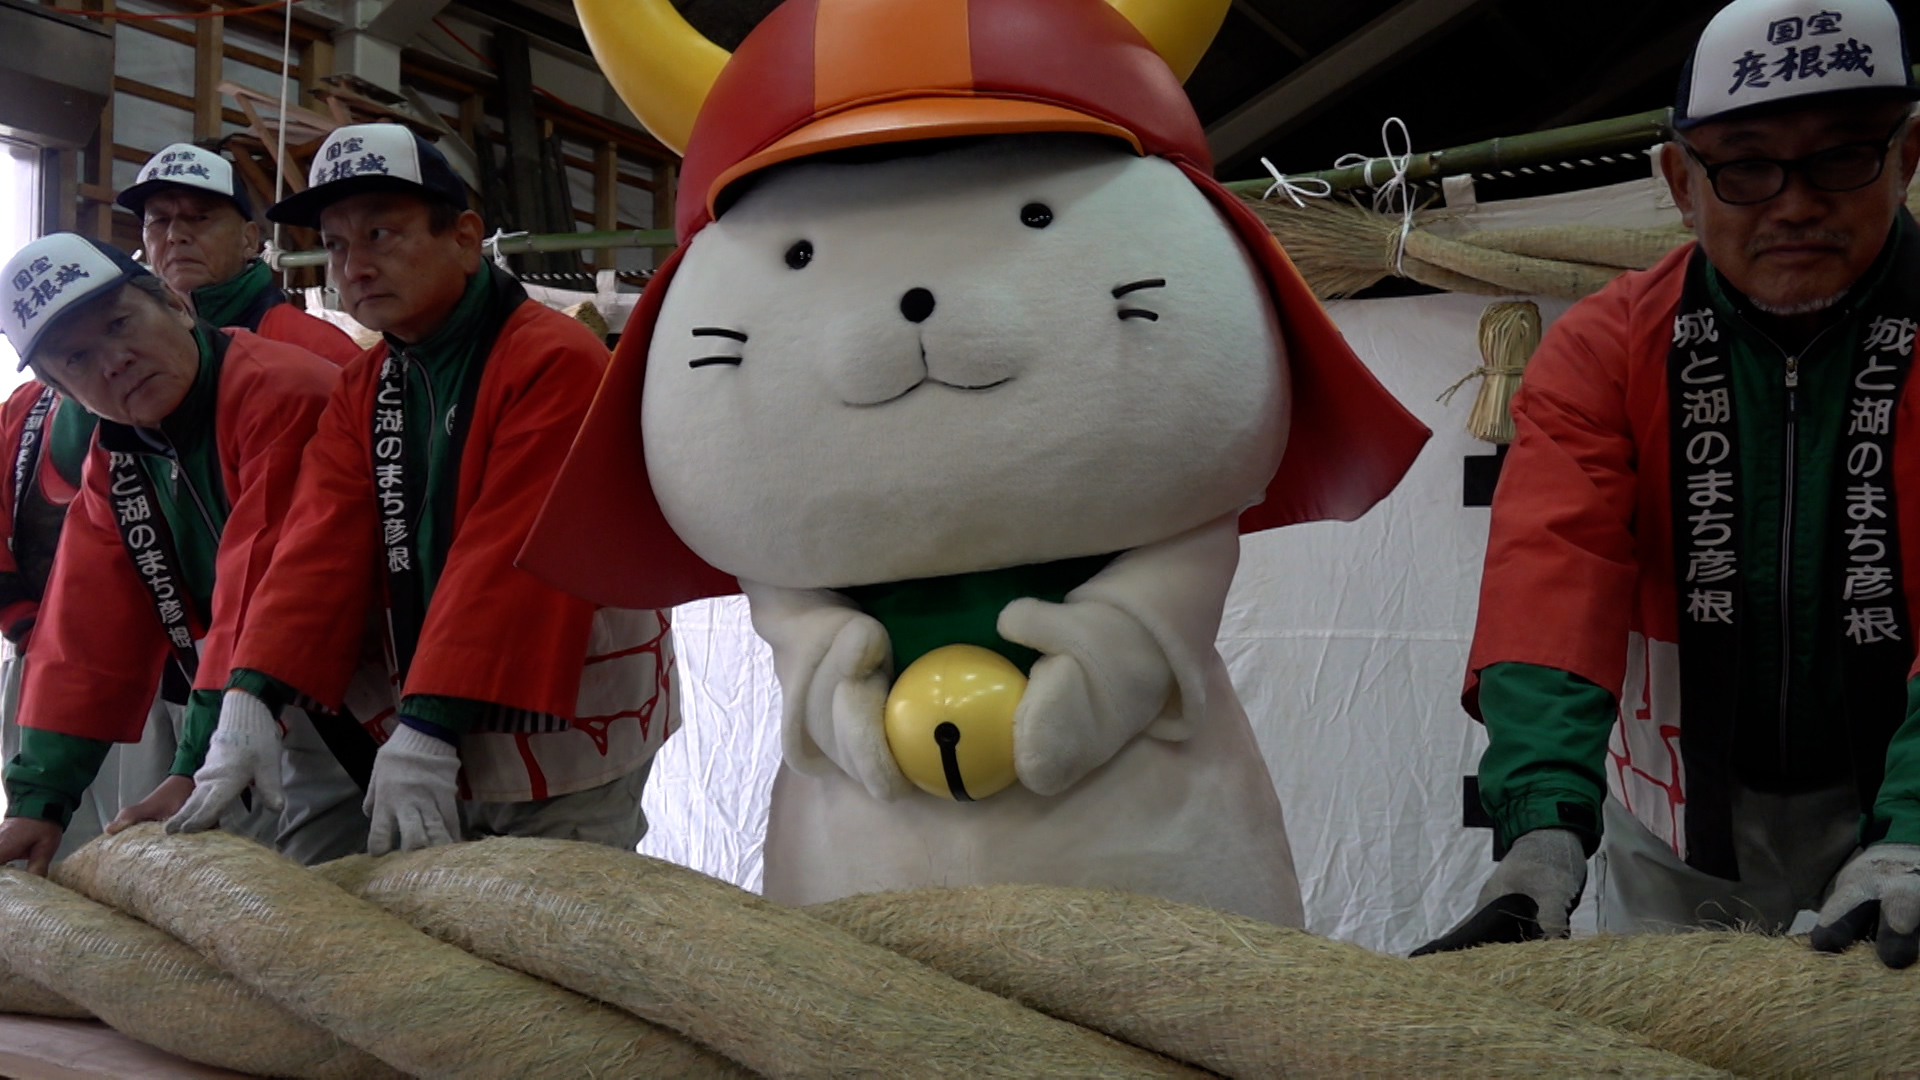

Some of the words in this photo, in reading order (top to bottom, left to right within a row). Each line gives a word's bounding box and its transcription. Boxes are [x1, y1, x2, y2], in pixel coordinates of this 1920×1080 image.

[1767, 9, 1843, 46] 国宝
[1728, 37, 1876, 96] 彦根城
[160, 151, 196, 165] 国宝
[325, 137, 364, 162] 国宝
[12, 255, 54, 292] 国宝
[12, 263, 90, 330] 彦根城
[1671, 307, 1737, 625] 城と湖のまち彦根
[1842, 314, 1918, 645] 城と湖のまち彦根
